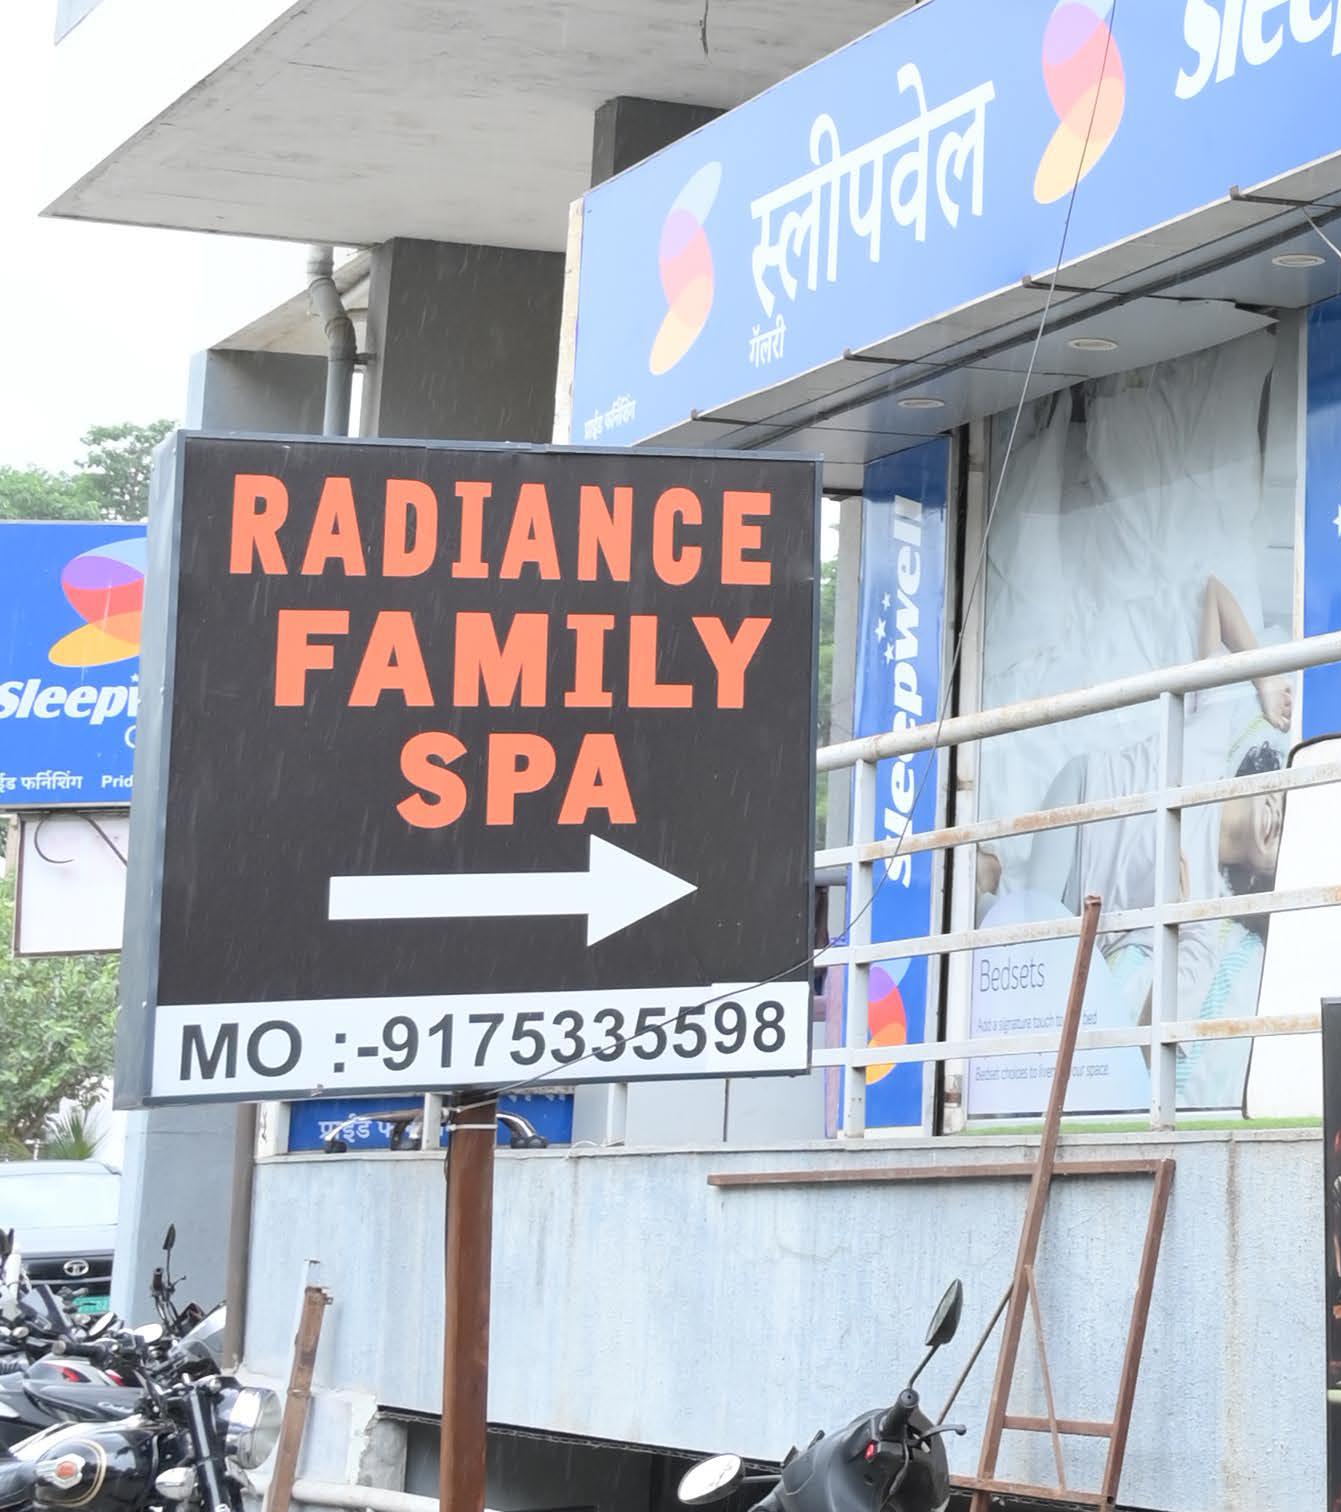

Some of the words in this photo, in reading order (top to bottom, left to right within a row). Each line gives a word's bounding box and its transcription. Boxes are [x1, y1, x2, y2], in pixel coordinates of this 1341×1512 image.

[750, 62, 995, 318] स्लीपवेल
[230, 474, 774, 586] RADIANCE
[274, 610, 772, 709] FAMILY
[0, 678, 139, 725] Sleep
[101, 774, 135, 789] Prid
[397, 732, 637, 829] SPA
[980, 957, 1046, 993] Bedsets
[180, 1019, 302, 1083] MO
